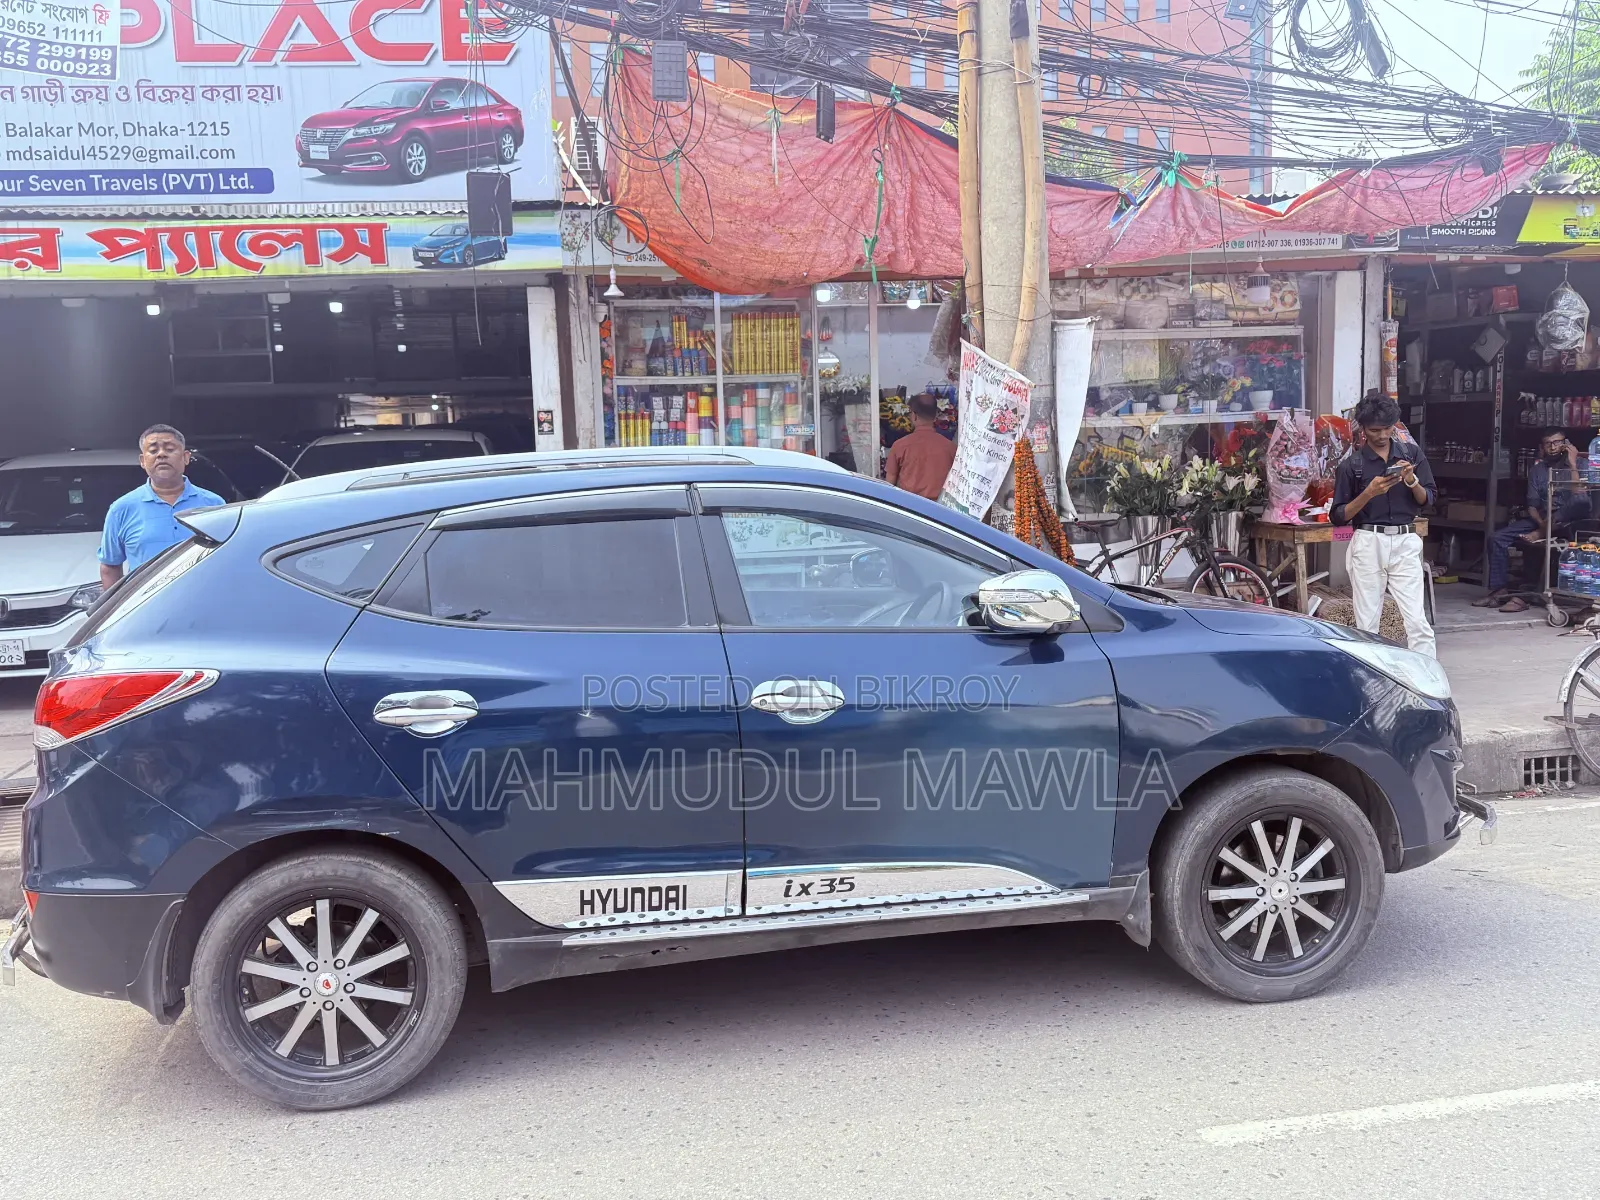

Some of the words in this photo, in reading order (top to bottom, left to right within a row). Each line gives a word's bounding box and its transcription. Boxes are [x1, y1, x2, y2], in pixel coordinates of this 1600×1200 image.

[52, 25, 102, 43] 111111
[0, 33, 31, 52] 72
[37, 42, 113, 61] 299199
[0, 50, 29, 67] 55
[36, 57, 112, 76] 000923
[115, 85, 131, 102] ও
[136, 79, 195, 105] বিক্রয়
[200, 85, 241, 103] করা
[5, 121, 73, 138] Balakar
[78, 122, 118, 140] Mor,
[122, 121, 231, 138] Dhaka-1215
[6, 145, 236, 163] mdsaidul4529@gmail.com
[28, 174, 87, 192] Seven
[89, 174, 158, 191] Travels
[162, 172, 215, 192] (PVT)
[219, 173, 255, 190] Ltd.
[1431, 228, 1467, 236] SMOOTH
[1468, 228, 1497, 236] RIDING
[86, 222, 390, 276] প্যালেস
[1328, 238, 1338, 246] 741
[986, 448, 1008, 463] Kinds
[579, 884, 688, 915] HYUNDAI
[783, 876, 856, 898] ix35
